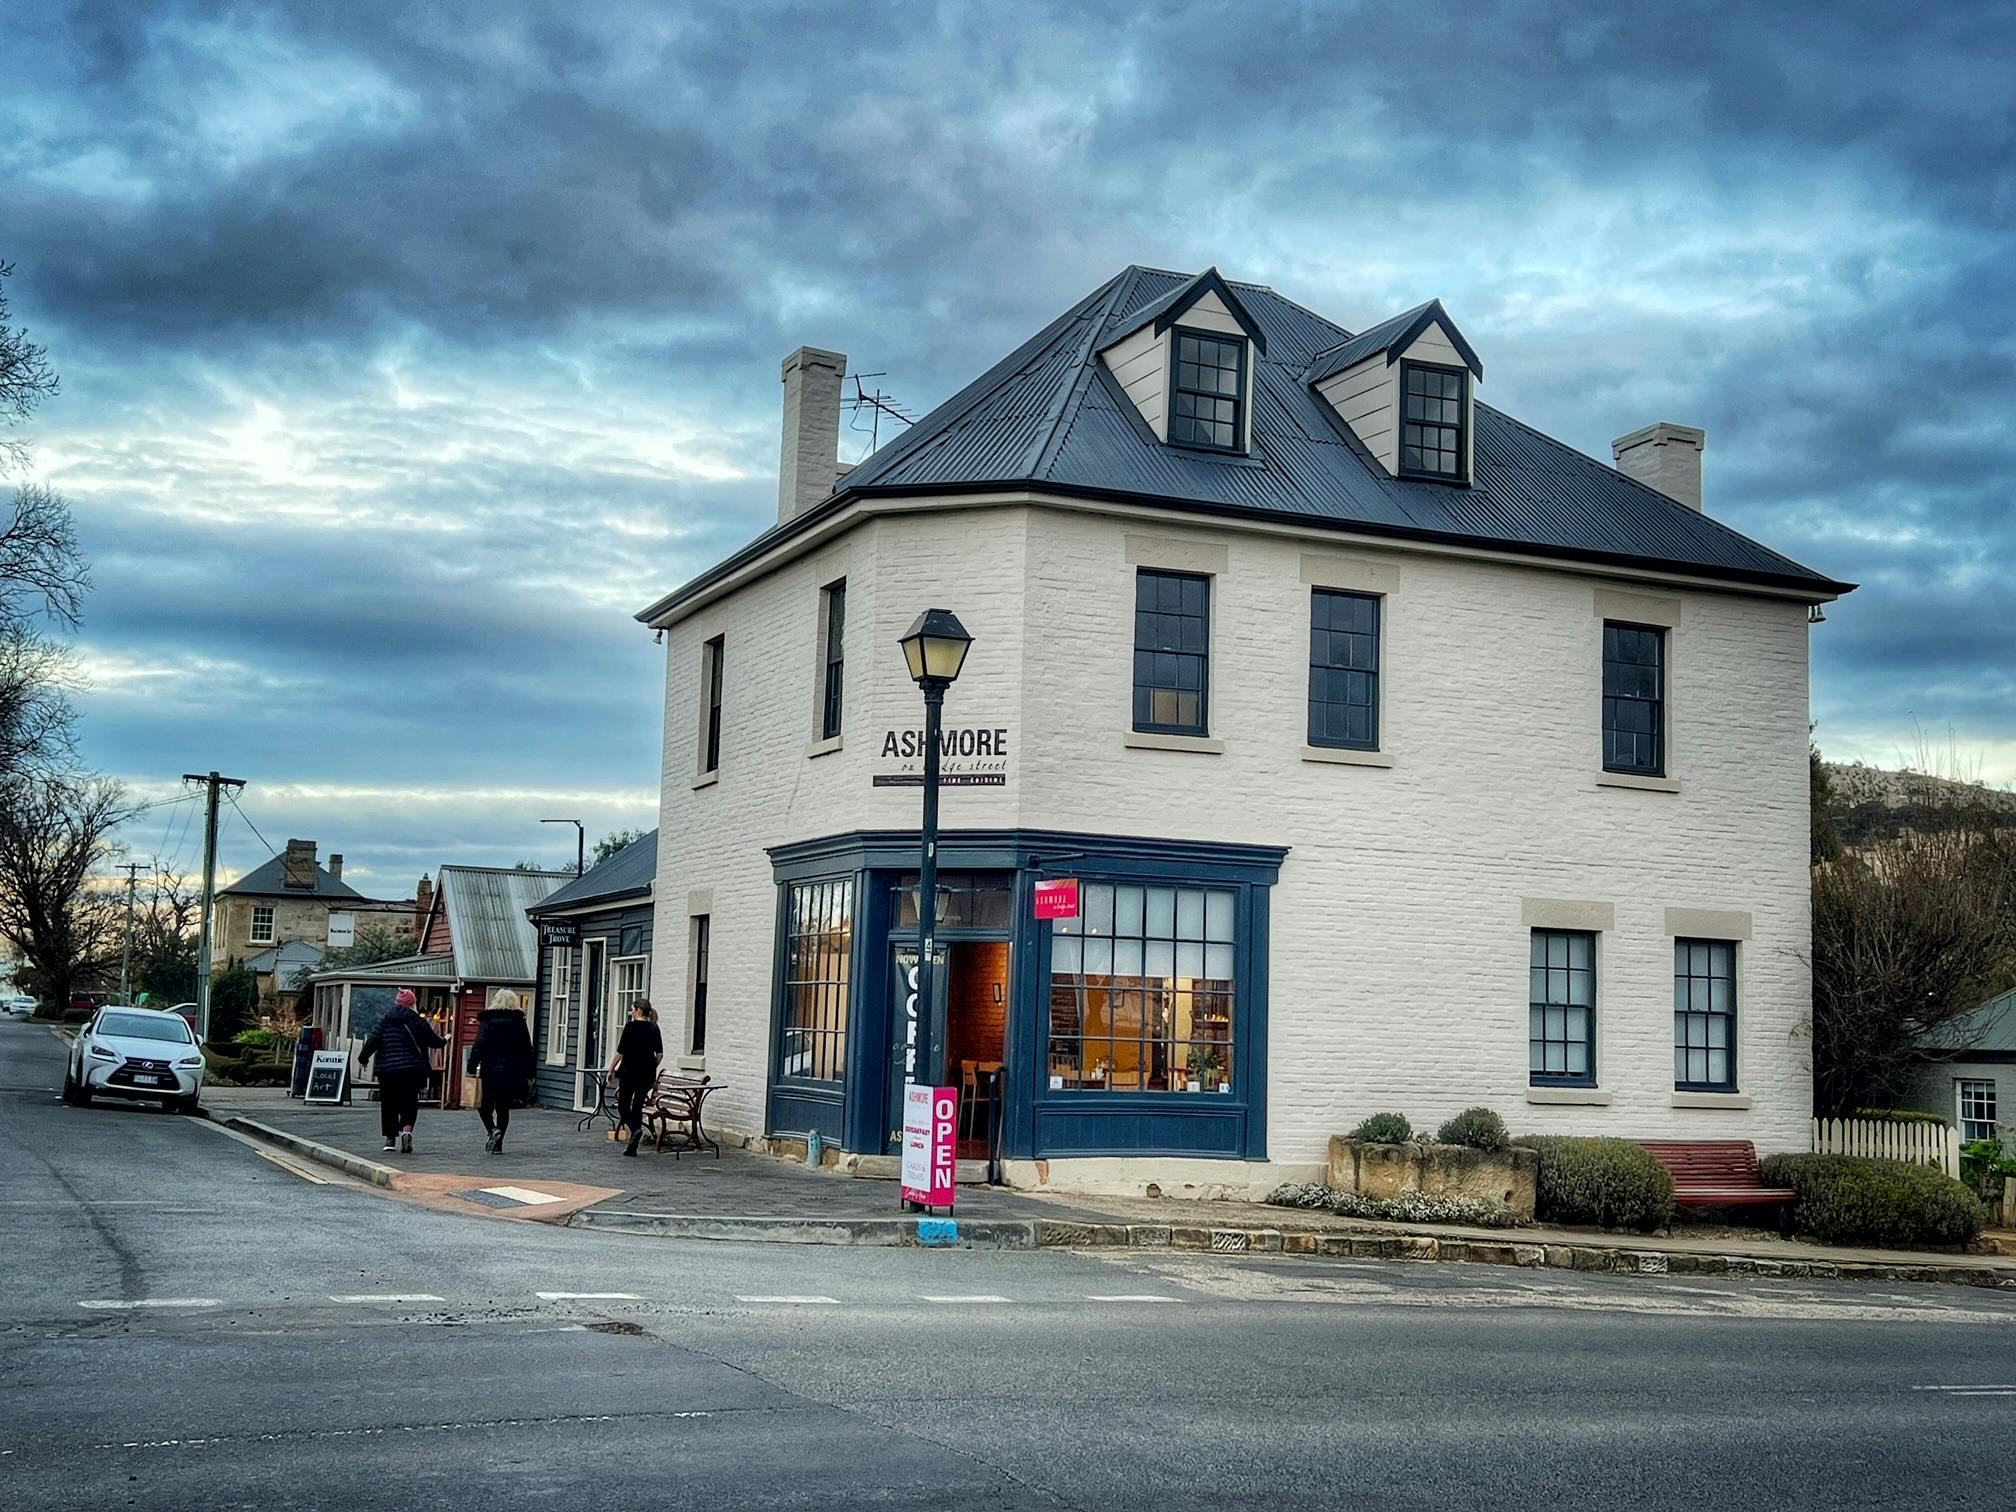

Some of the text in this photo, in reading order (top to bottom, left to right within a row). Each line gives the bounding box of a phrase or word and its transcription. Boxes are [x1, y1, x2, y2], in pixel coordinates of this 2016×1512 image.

[969, 760, 1006, 771] street
[896, 955, 945, 965] NOW EN
[314, 1071, 337, 1080] Local
[312, 1082, 333, 1091] Art
[935, 1099, 954, 1189] OPEN
